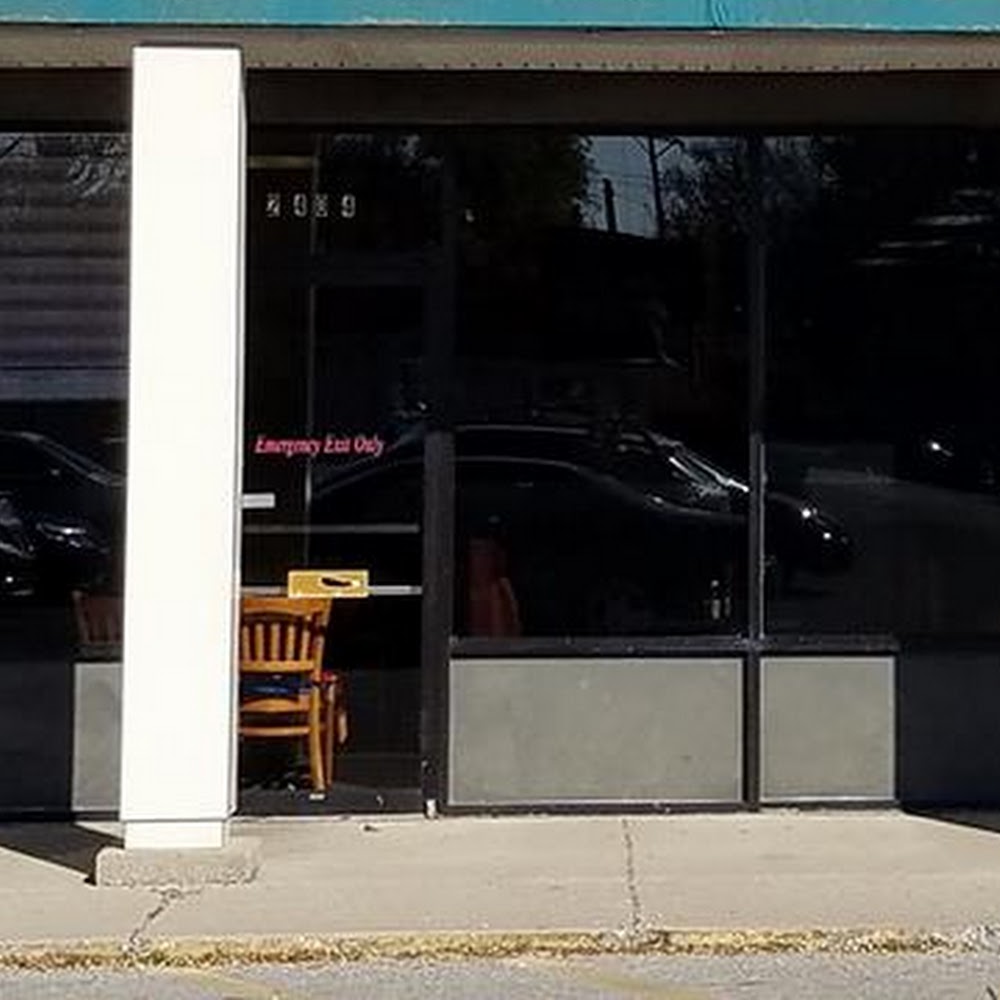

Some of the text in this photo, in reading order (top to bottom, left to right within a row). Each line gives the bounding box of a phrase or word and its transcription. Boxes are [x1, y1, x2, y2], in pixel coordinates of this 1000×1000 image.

[254, 433, 386, 458] Emergency Exit Only
